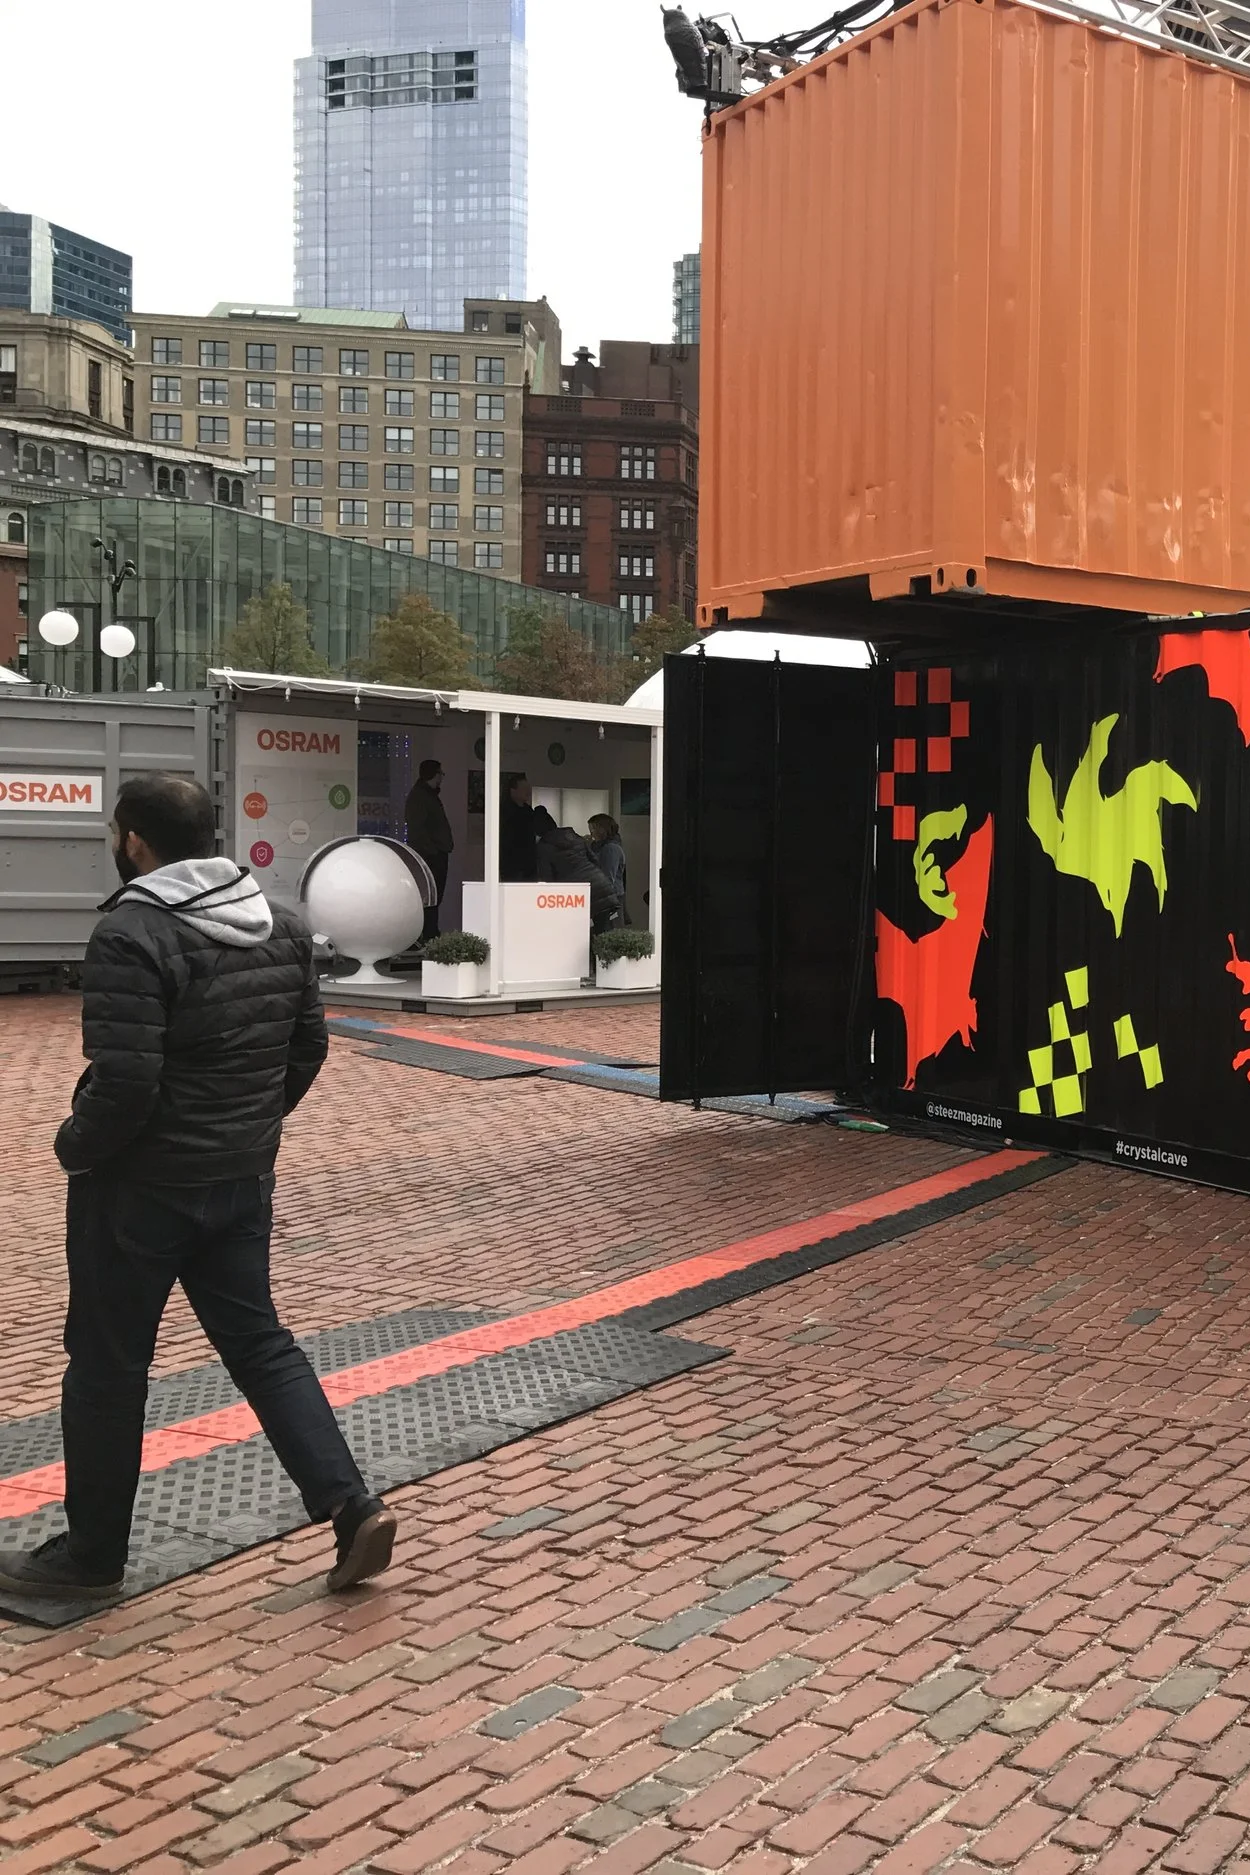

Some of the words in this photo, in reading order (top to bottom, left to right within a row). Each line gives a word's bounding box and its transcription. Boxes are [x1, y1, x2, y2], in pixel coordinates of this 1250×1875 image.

[257, 728, 340, 754] OSRAM
[537, 894, 585, 909] OSRAM
[926, 1101, 1003, 1129] @steezmagazine
[1115, 1140, 1188, 1167] #crystalcave
